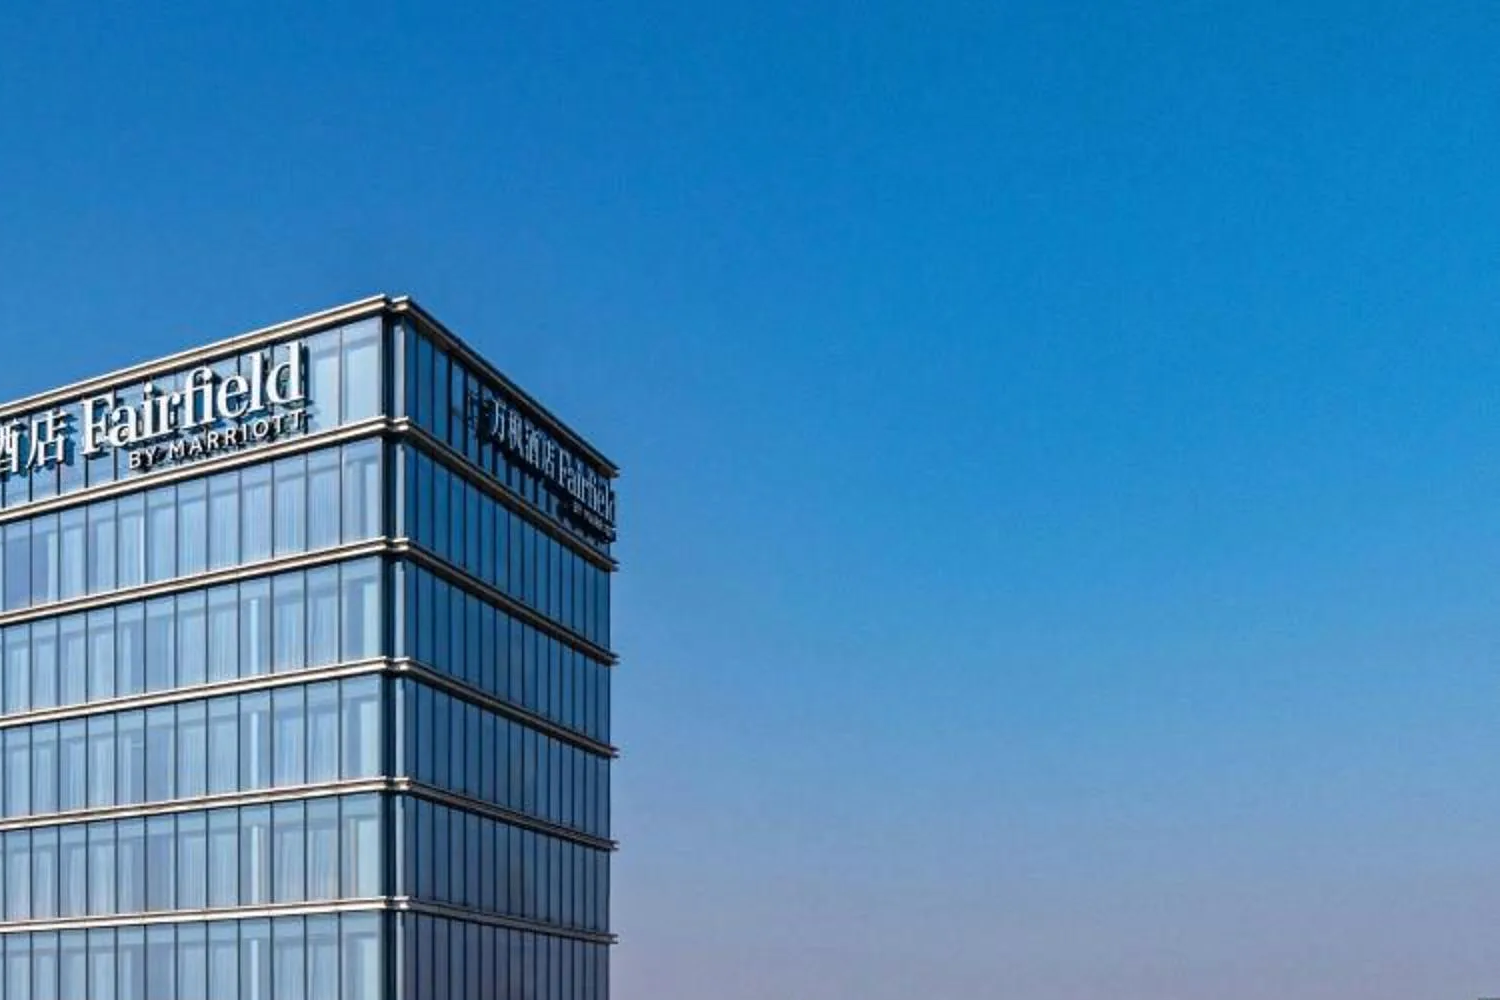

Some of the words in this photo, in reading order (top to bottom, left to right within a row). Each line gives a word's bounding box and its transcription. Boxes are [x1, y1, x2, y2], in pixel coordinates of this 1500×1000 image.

[81, 341, 304, 456] Fairfield
[130, 450, 158, 469] BY
[169, 409, 306, 458] MARRIOTT
